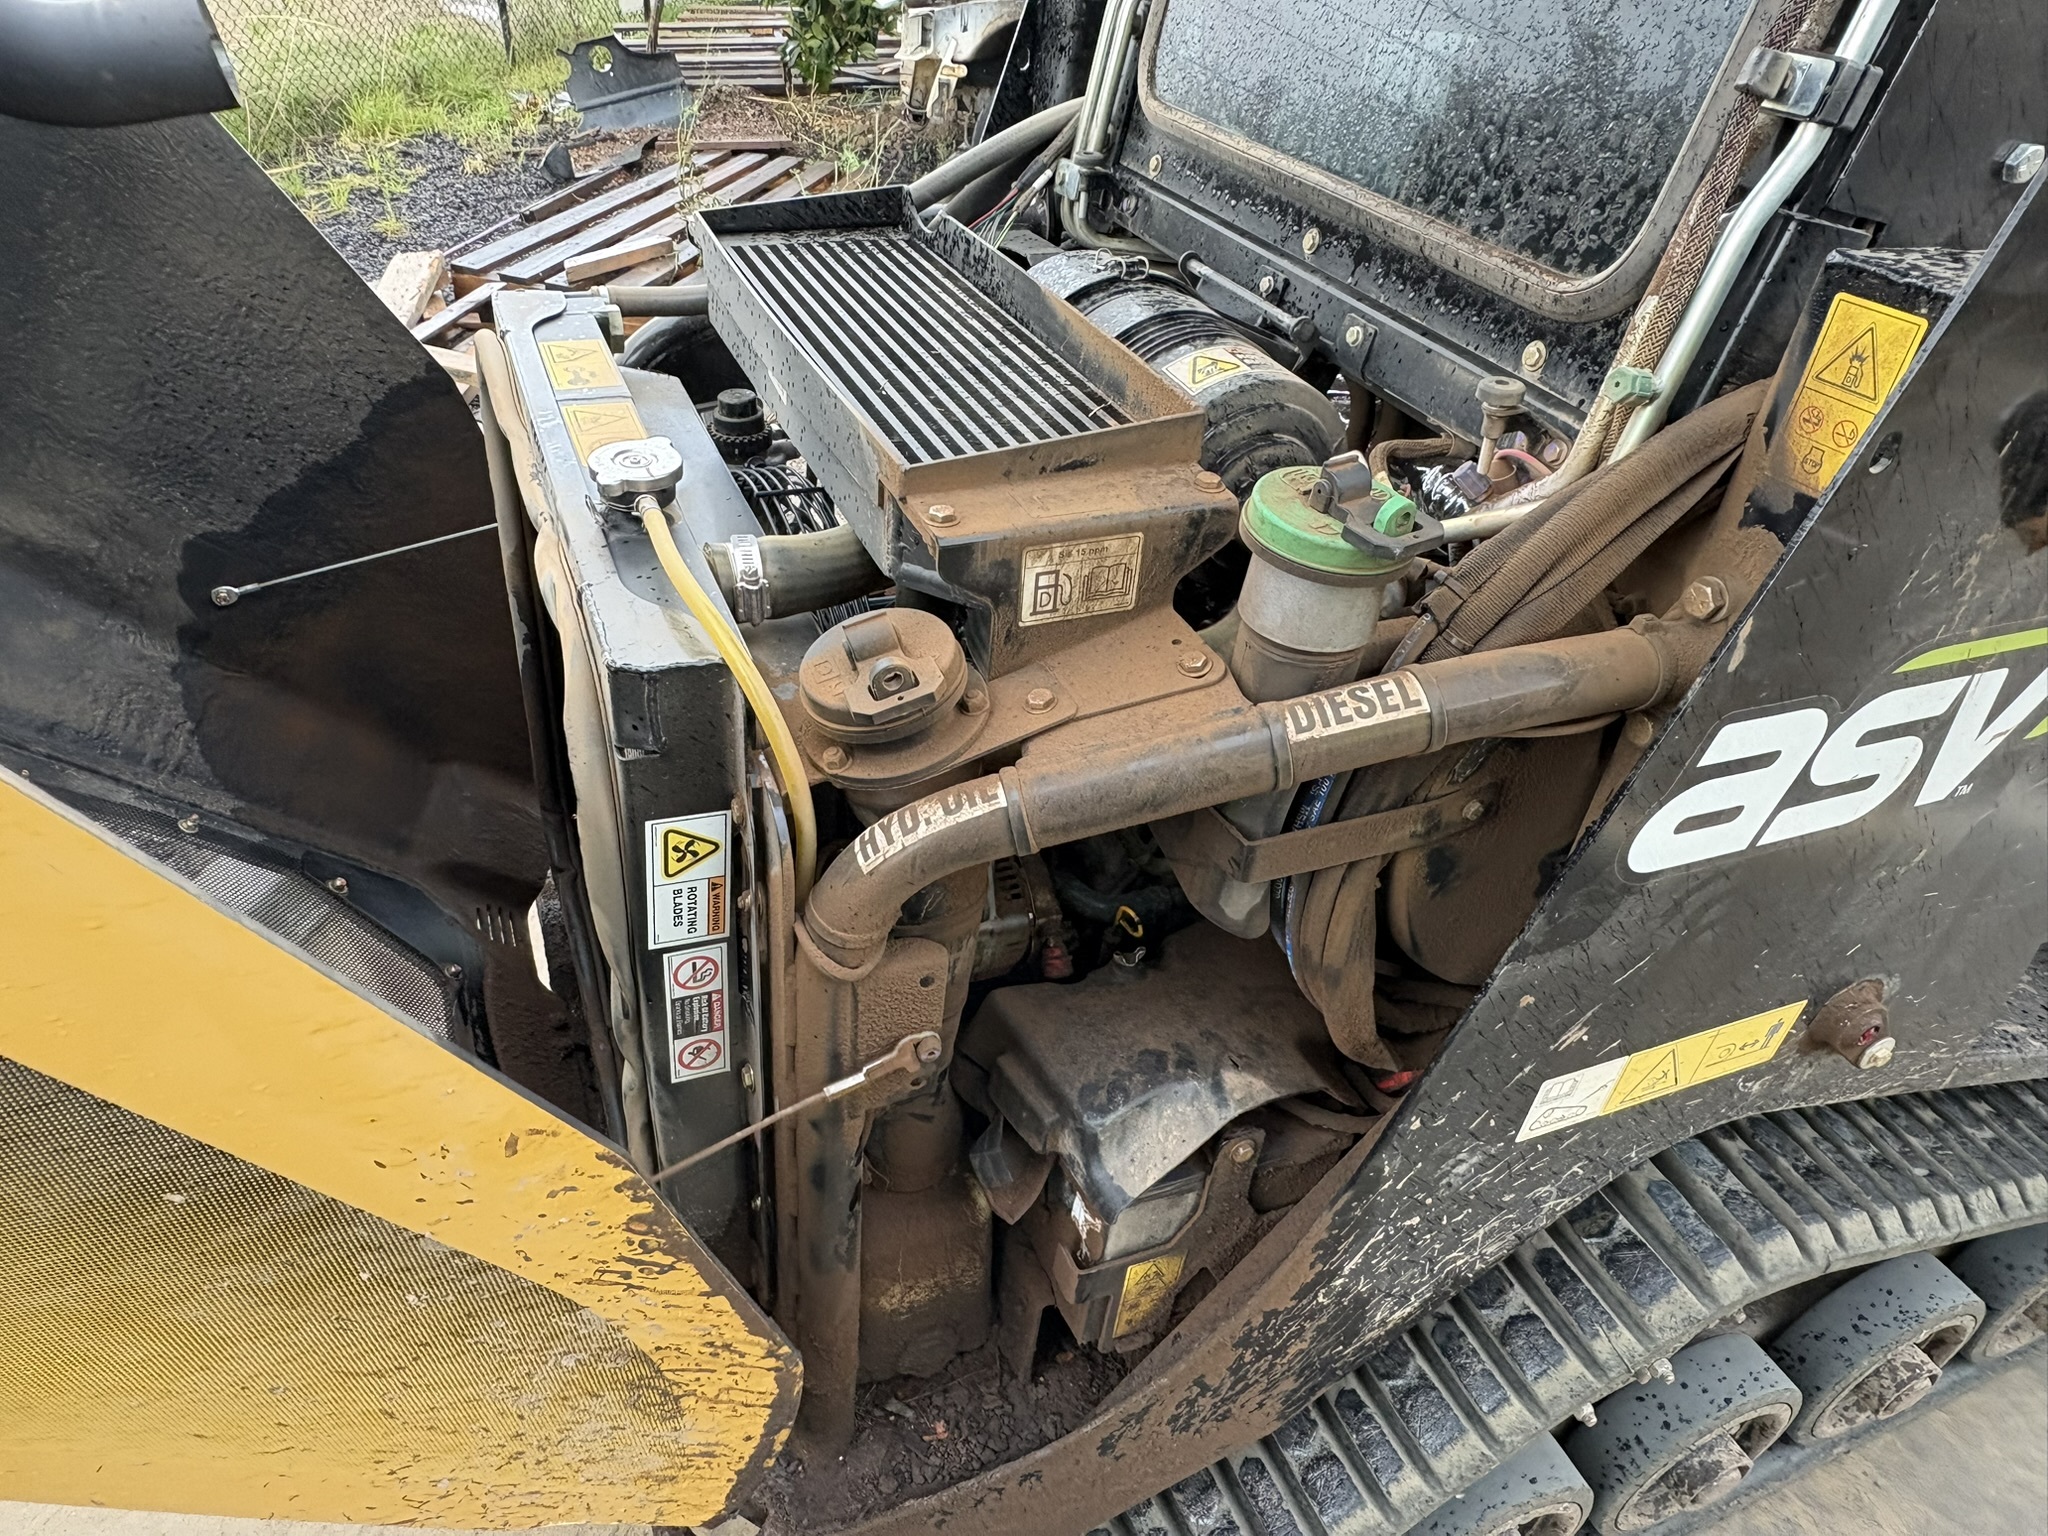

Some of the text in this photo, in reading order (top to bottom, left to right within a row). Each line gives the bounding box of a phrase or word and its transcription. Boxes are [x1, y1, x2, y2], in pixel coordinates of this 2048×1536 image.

[1803, 457, 1821, 468] STOP
[1286, 676, 1423, 735] DIESEL
[672, 888, 684, 928] BLADES
[687, 886, 698, 935] ROTATING
[711, 891, 721, 932] WARNING
[713, 1001, 722, 1029] DANGER
